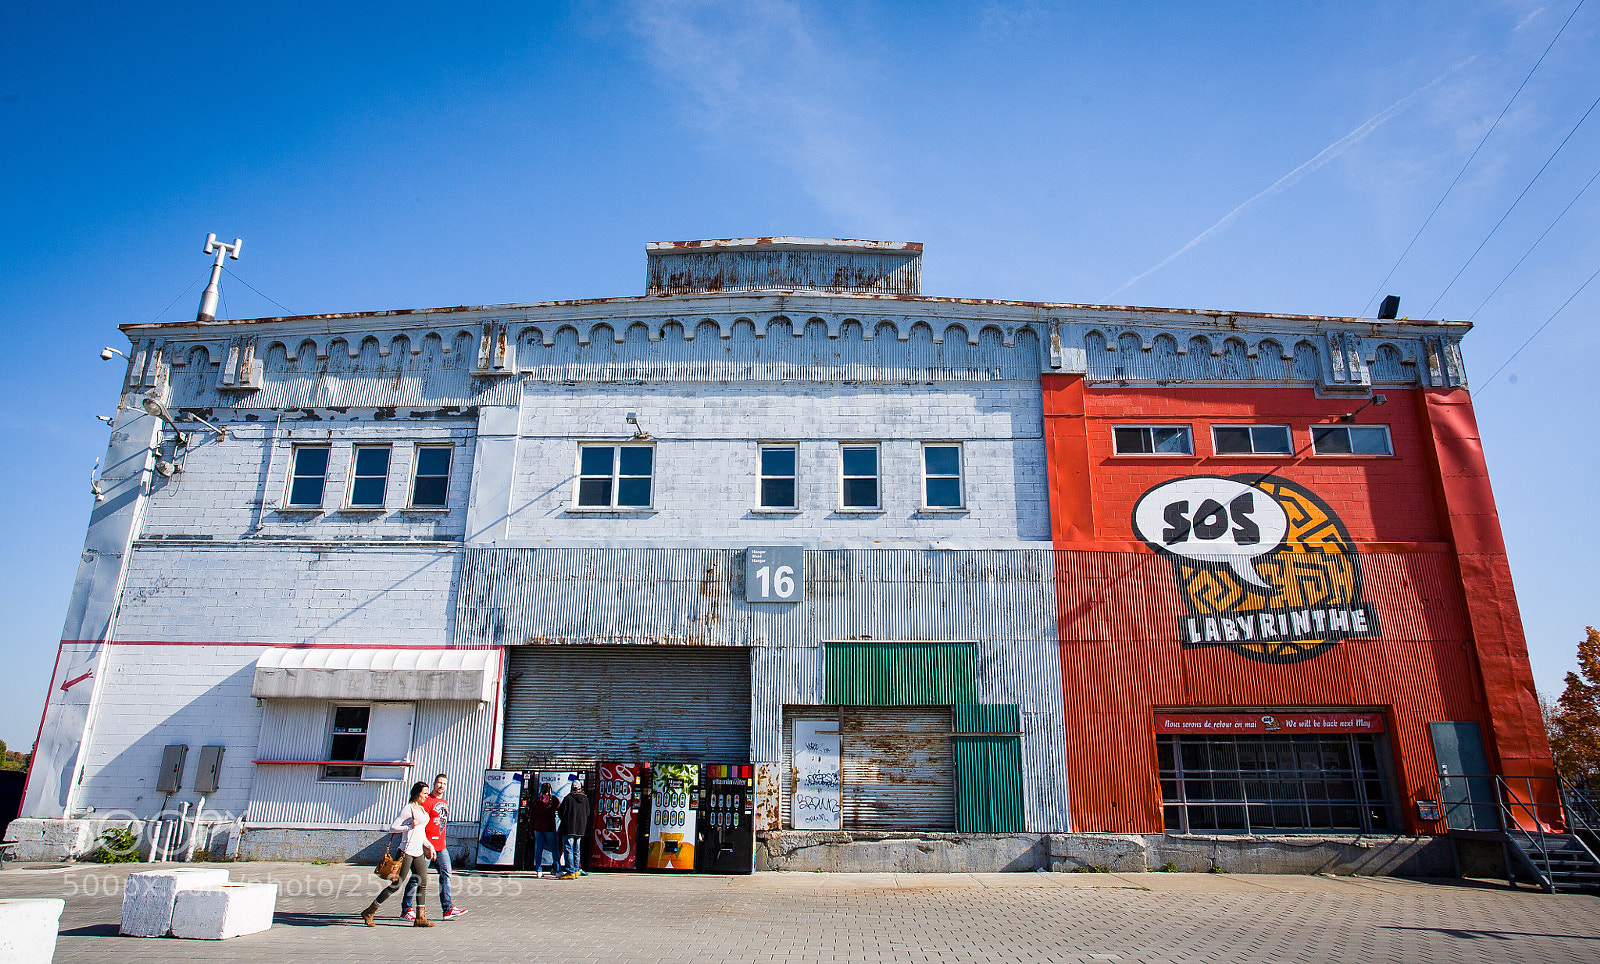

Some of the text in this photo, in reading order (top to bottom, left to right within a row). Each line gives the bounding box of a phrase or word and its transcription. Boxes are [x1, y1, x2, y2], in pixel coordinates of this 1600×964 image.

[1163, 492, 1260, 545] SOS
[756, 565, 795, 599] 16
[1187, 608, 1368, 643] LABYRINTHE
[1164, 719, 1180, 728] Nous
[1203, 719, 1212, 728] de
[1213, 720, 1232, 728] retour
[1244, 720, 1257, 728] mai
[1285, 719, 1297, 728] We
[1299, 719, 1311, 728] will
[1313, 719, 1321, 728] be
[1322, 719, 1338, 728] back
[1340, 719, 1354, 727] next
[1356, 719, 1371, 728] May
